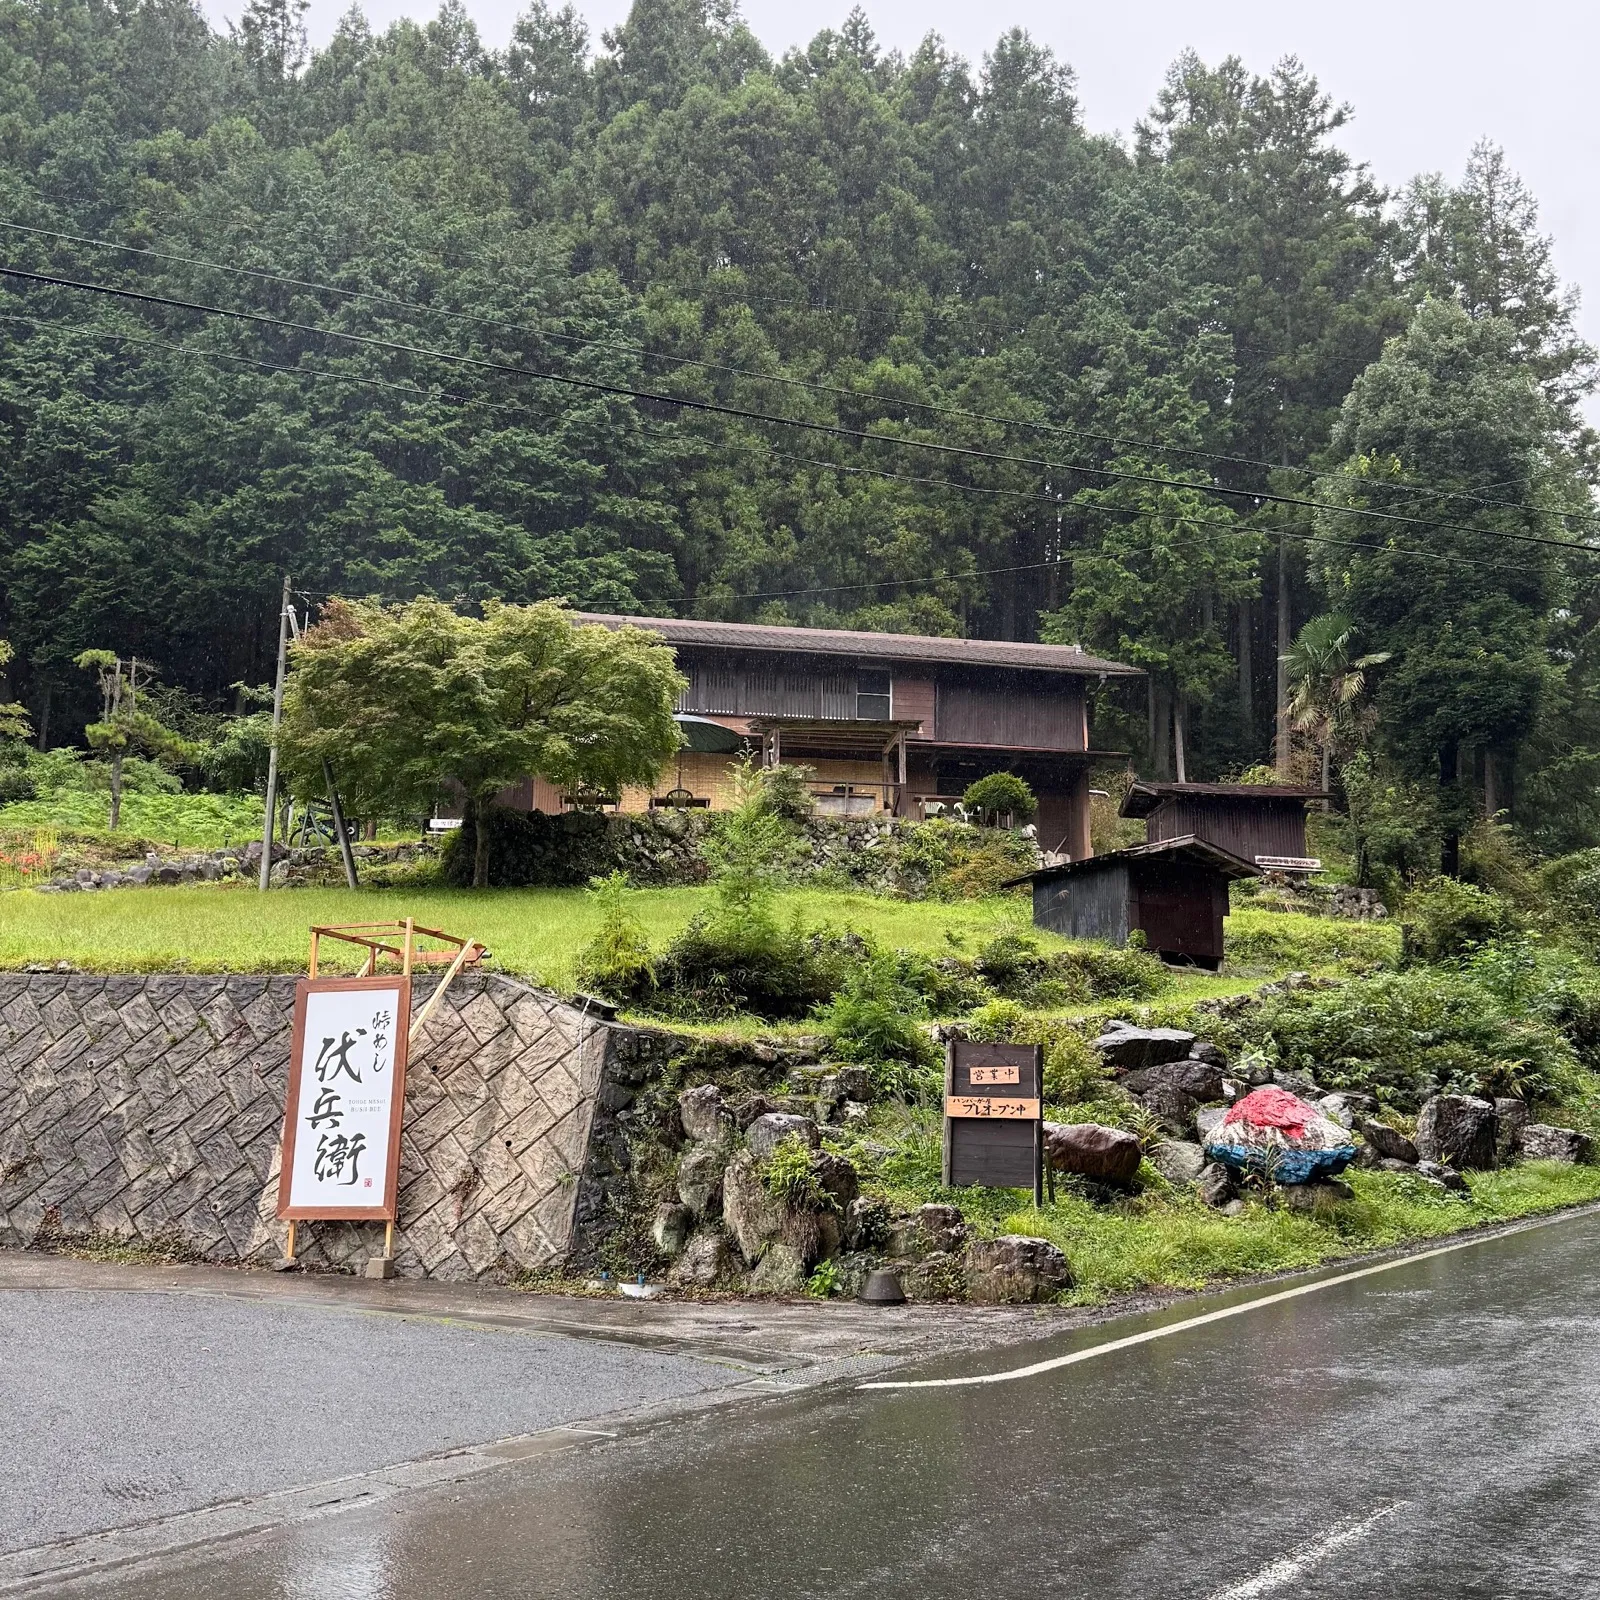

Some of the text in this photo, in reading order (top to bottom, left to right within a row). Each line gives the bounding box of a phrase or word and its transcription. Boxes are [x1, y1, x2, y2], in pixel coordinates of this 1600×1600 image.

[973, 1068, 1014, 1081] 営業中
[304, 1028, 367, 1185] 伏兵衛
[963, 1103, 1026, 1116] プレオープン中
